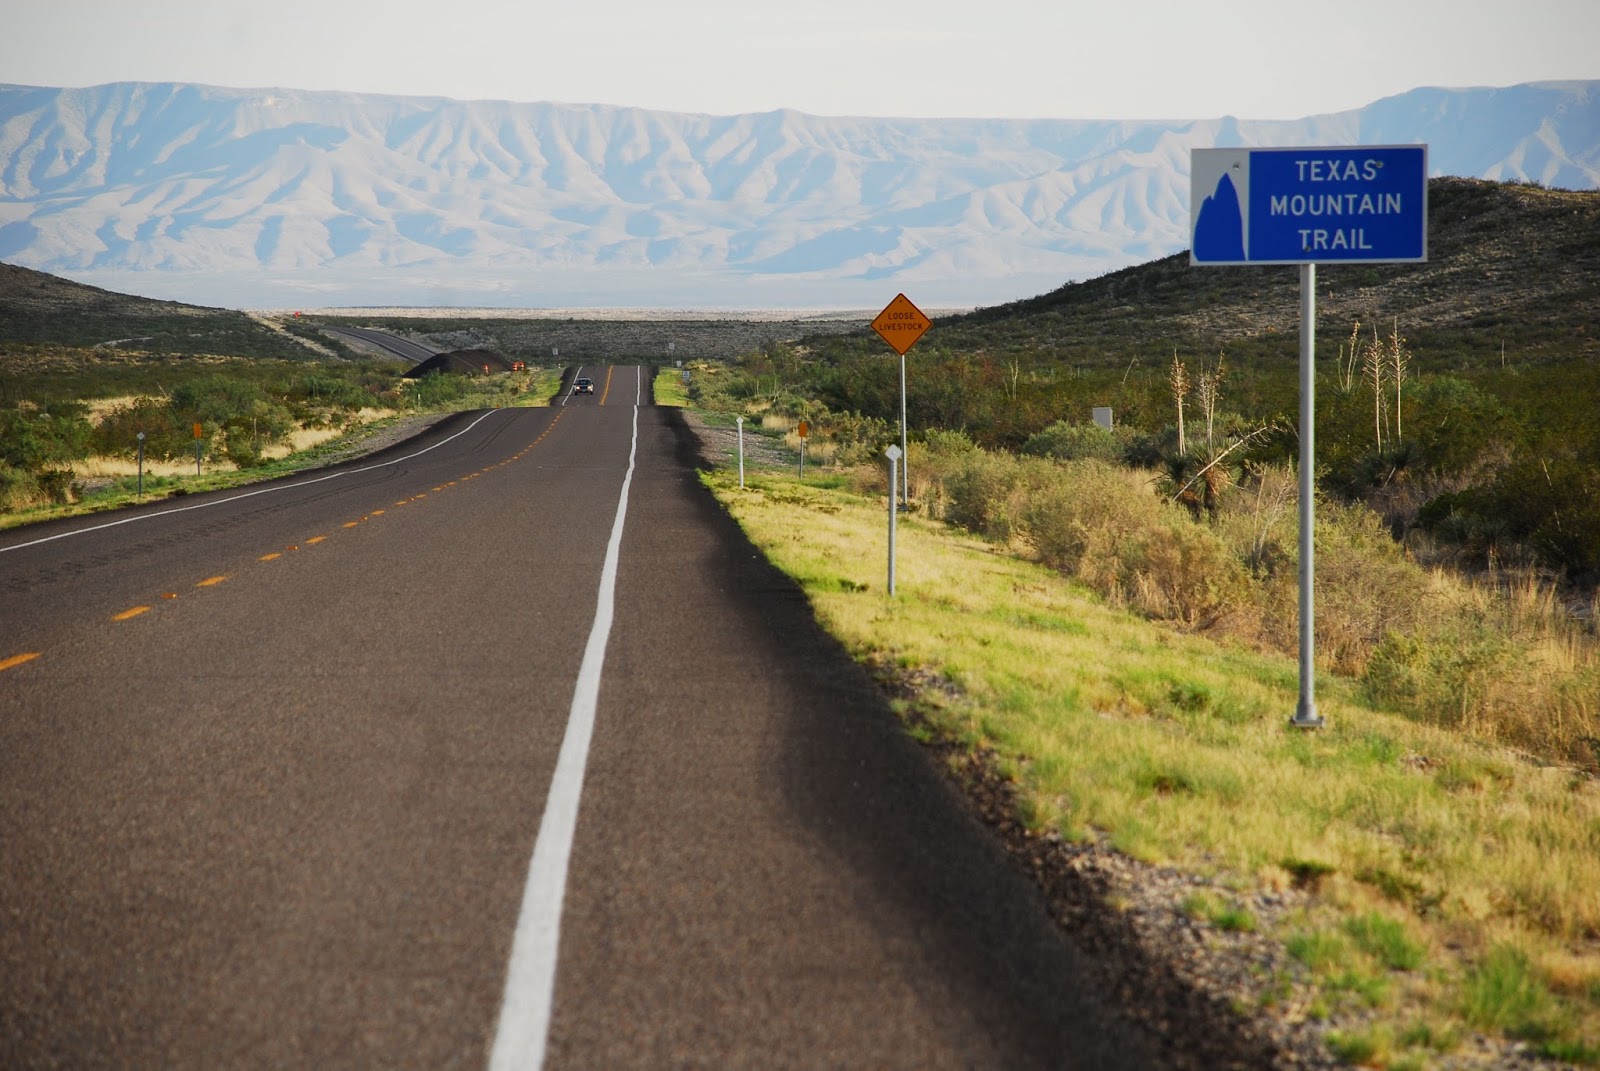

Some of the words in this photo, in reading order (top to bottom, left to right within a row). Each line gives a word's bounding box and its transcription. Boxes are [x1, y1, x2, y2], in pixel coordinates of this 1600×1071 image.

[1295, 159, 1377, 181] TEXAS
[1270, 193, 1401, 216] MOUNTAIN
[1298, 228, 1372, 250] TRAIL
[879, 322, 923, 331] LIVESTOCK
[887, 312, 915, 320] LOOSE
